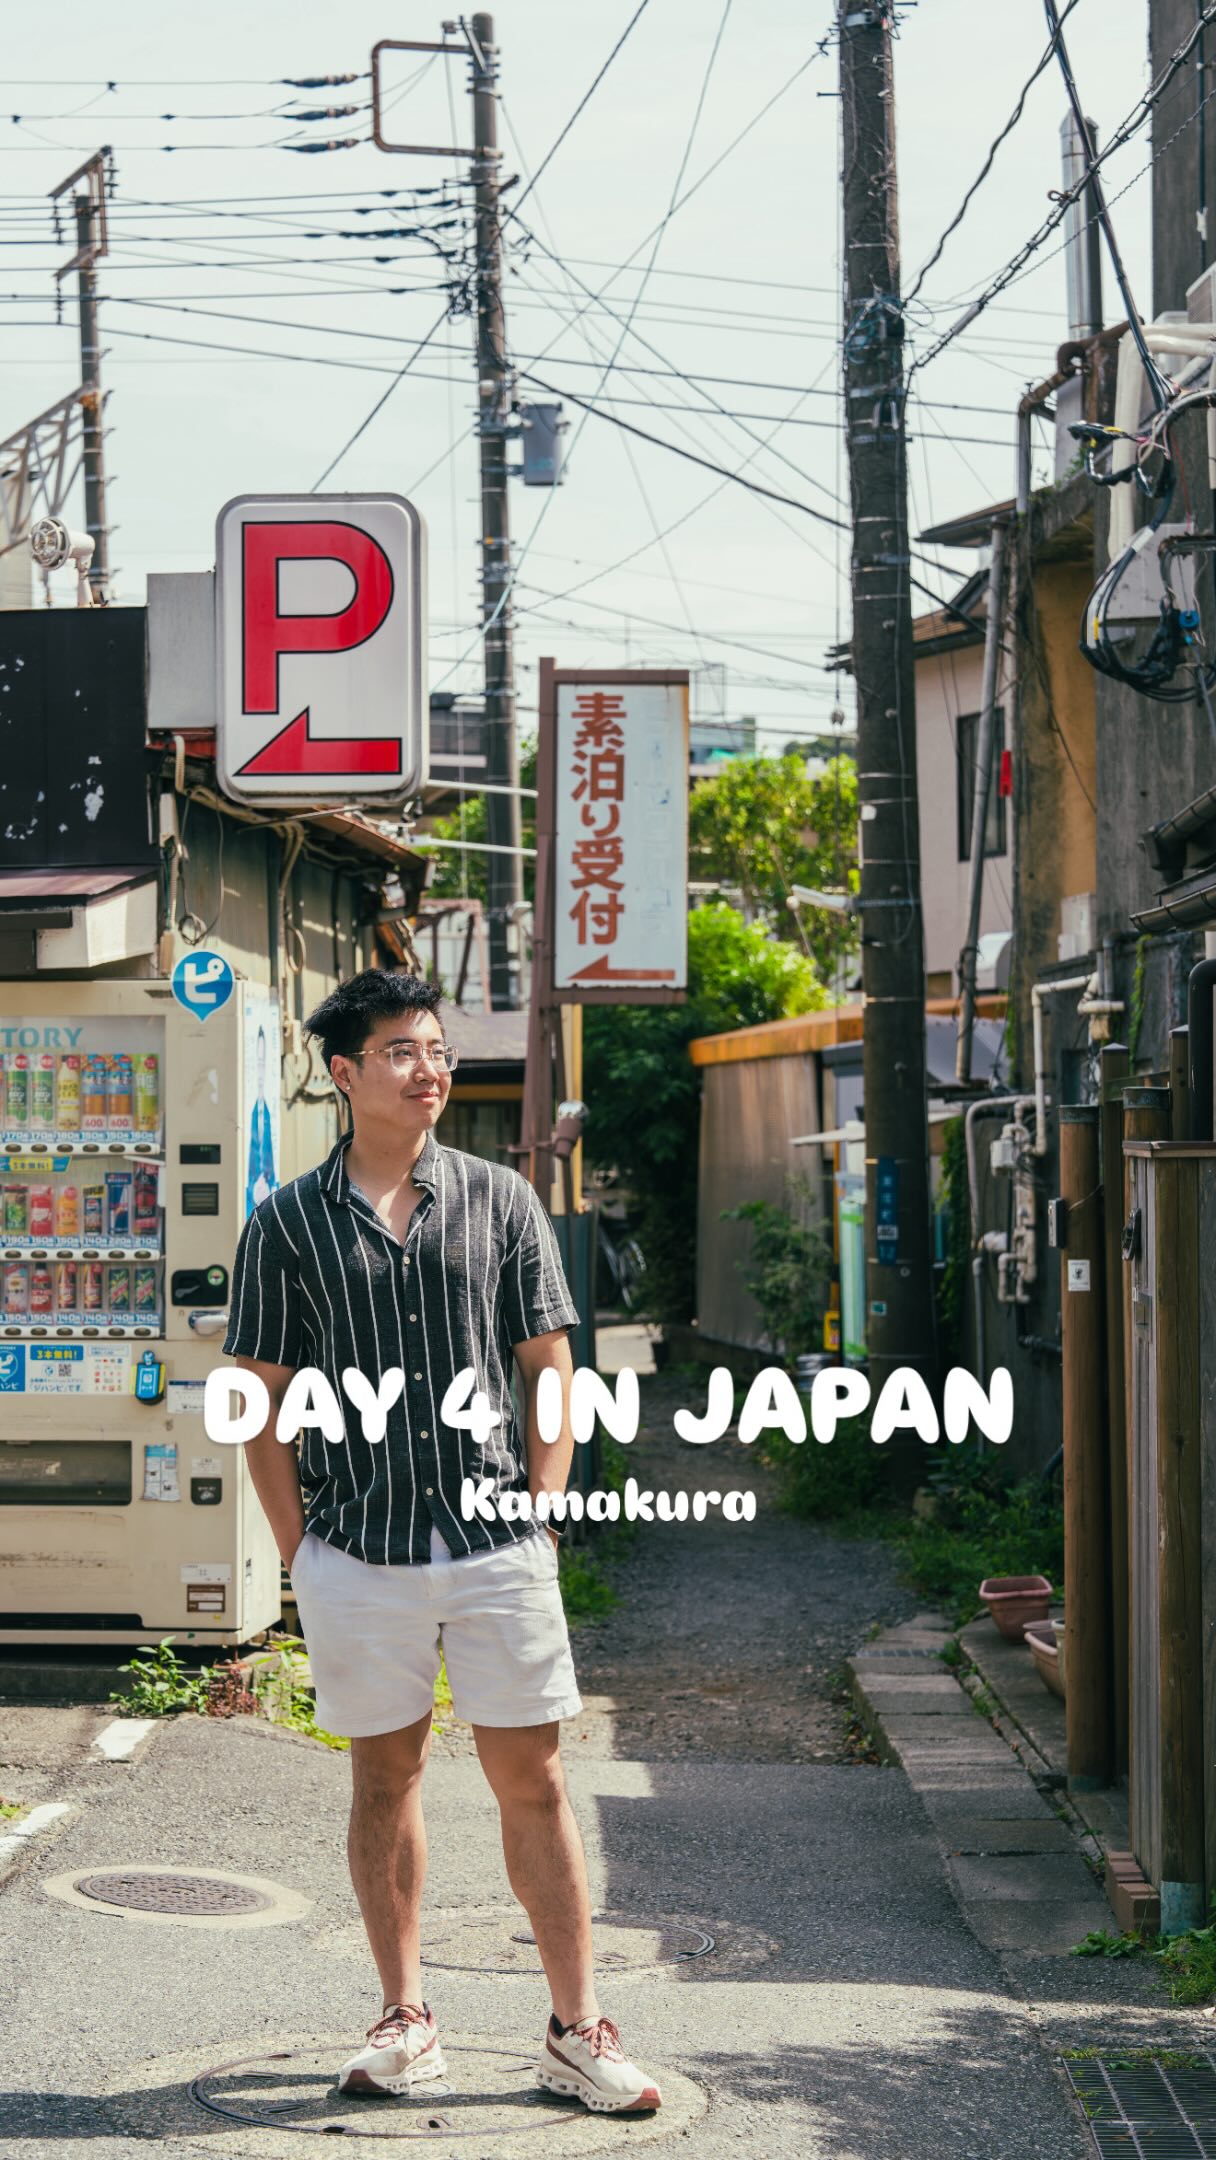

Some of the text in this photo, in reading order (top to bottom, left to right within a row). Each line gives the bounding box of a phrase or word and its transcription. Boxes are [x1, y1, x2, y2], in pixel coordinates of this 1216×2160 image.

[241, 520, 394, 715] P
[569, 692, 627, 945] 素泊り受付
[0, 1026, 83, 1049] TORY
[184, 956, 226, 1003] ピ
